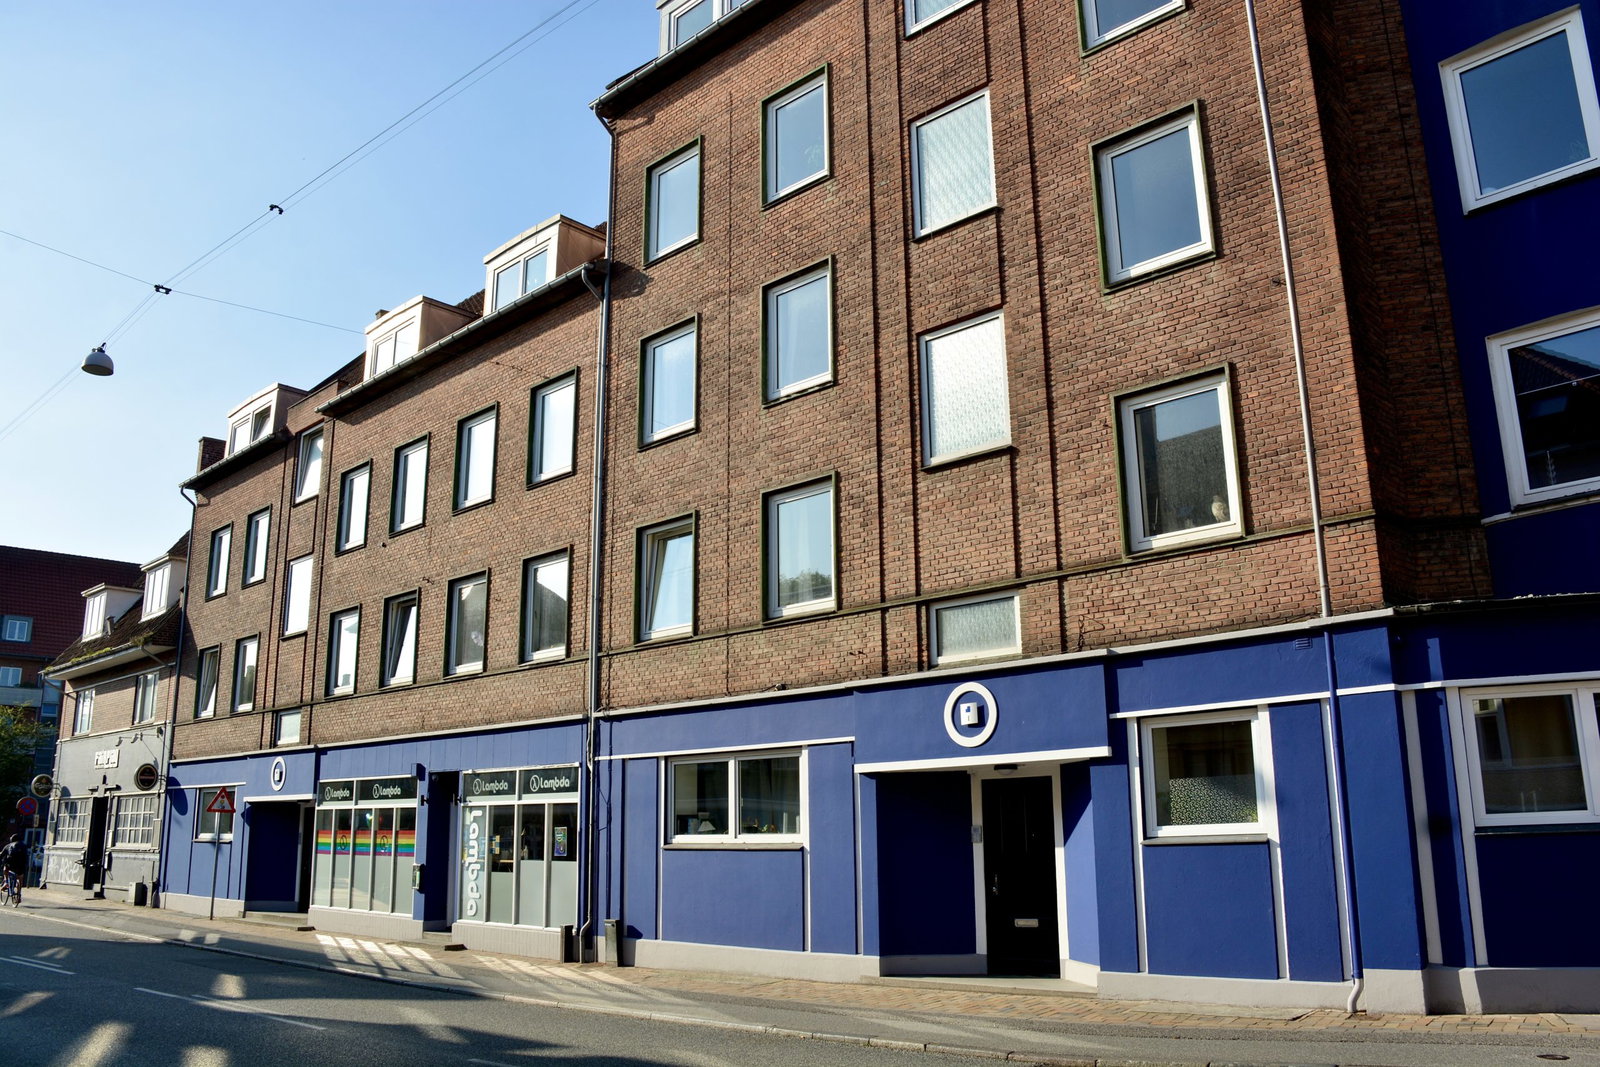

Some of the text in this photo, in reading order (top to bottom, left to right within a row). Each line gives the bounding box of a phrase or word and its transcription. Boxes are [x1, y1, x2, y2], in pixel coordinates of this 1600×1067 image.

[482, 780, 508, 793] Lambda
[540, 776, 570, 791] Lambda
[465, 810, 483, 917] Lambda
